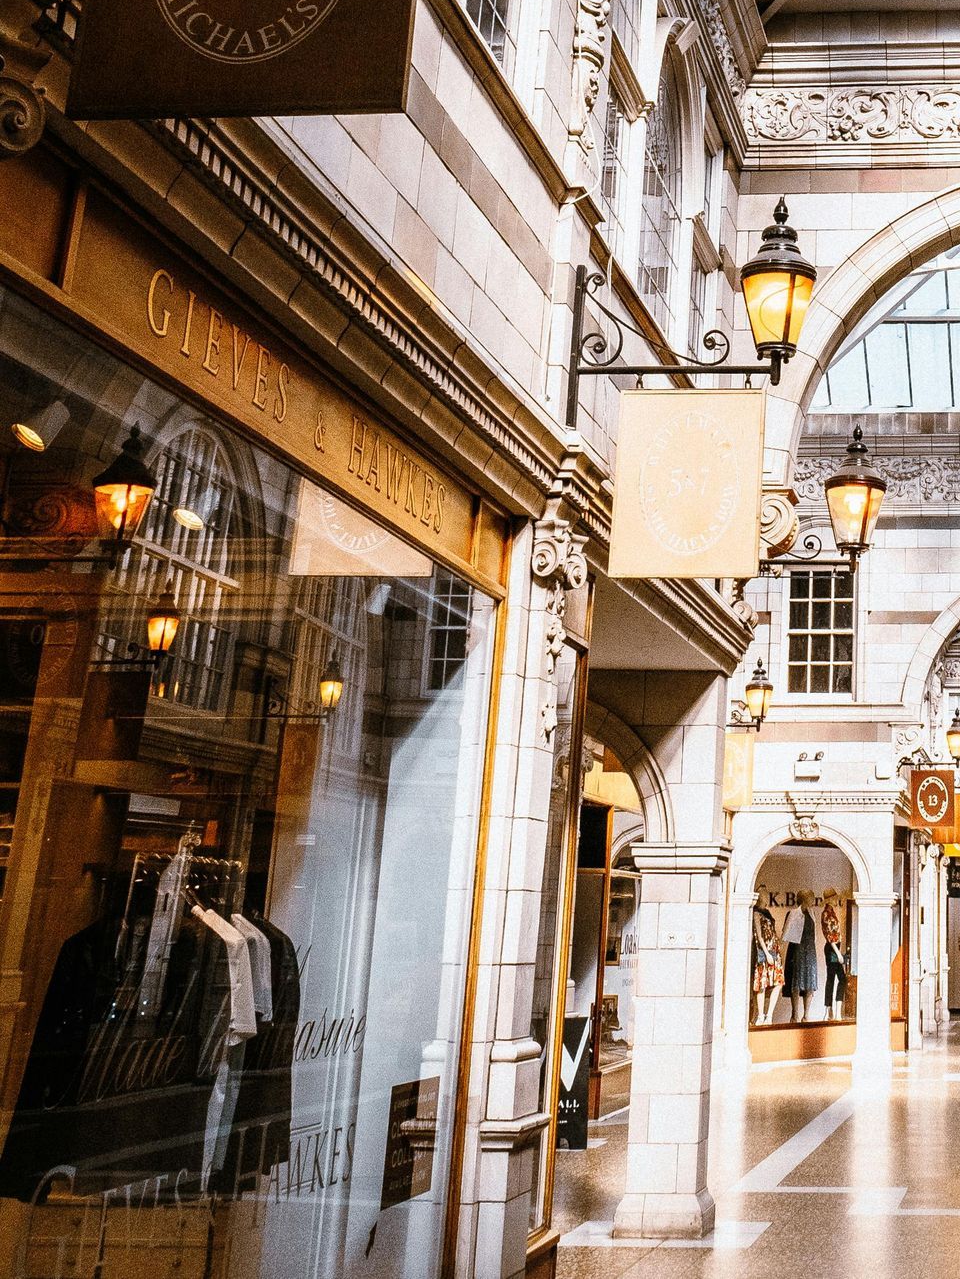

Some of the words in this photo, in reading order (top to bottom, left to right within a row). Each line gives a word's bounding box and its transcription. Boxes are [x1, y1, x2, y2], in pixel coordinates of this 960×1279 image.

[147, 268, 291, 424] GIEVES
[314, 410, 327, 454] &
[347, 415, 448, 534] HAWKES
[928, 794, 939, 807] 13
